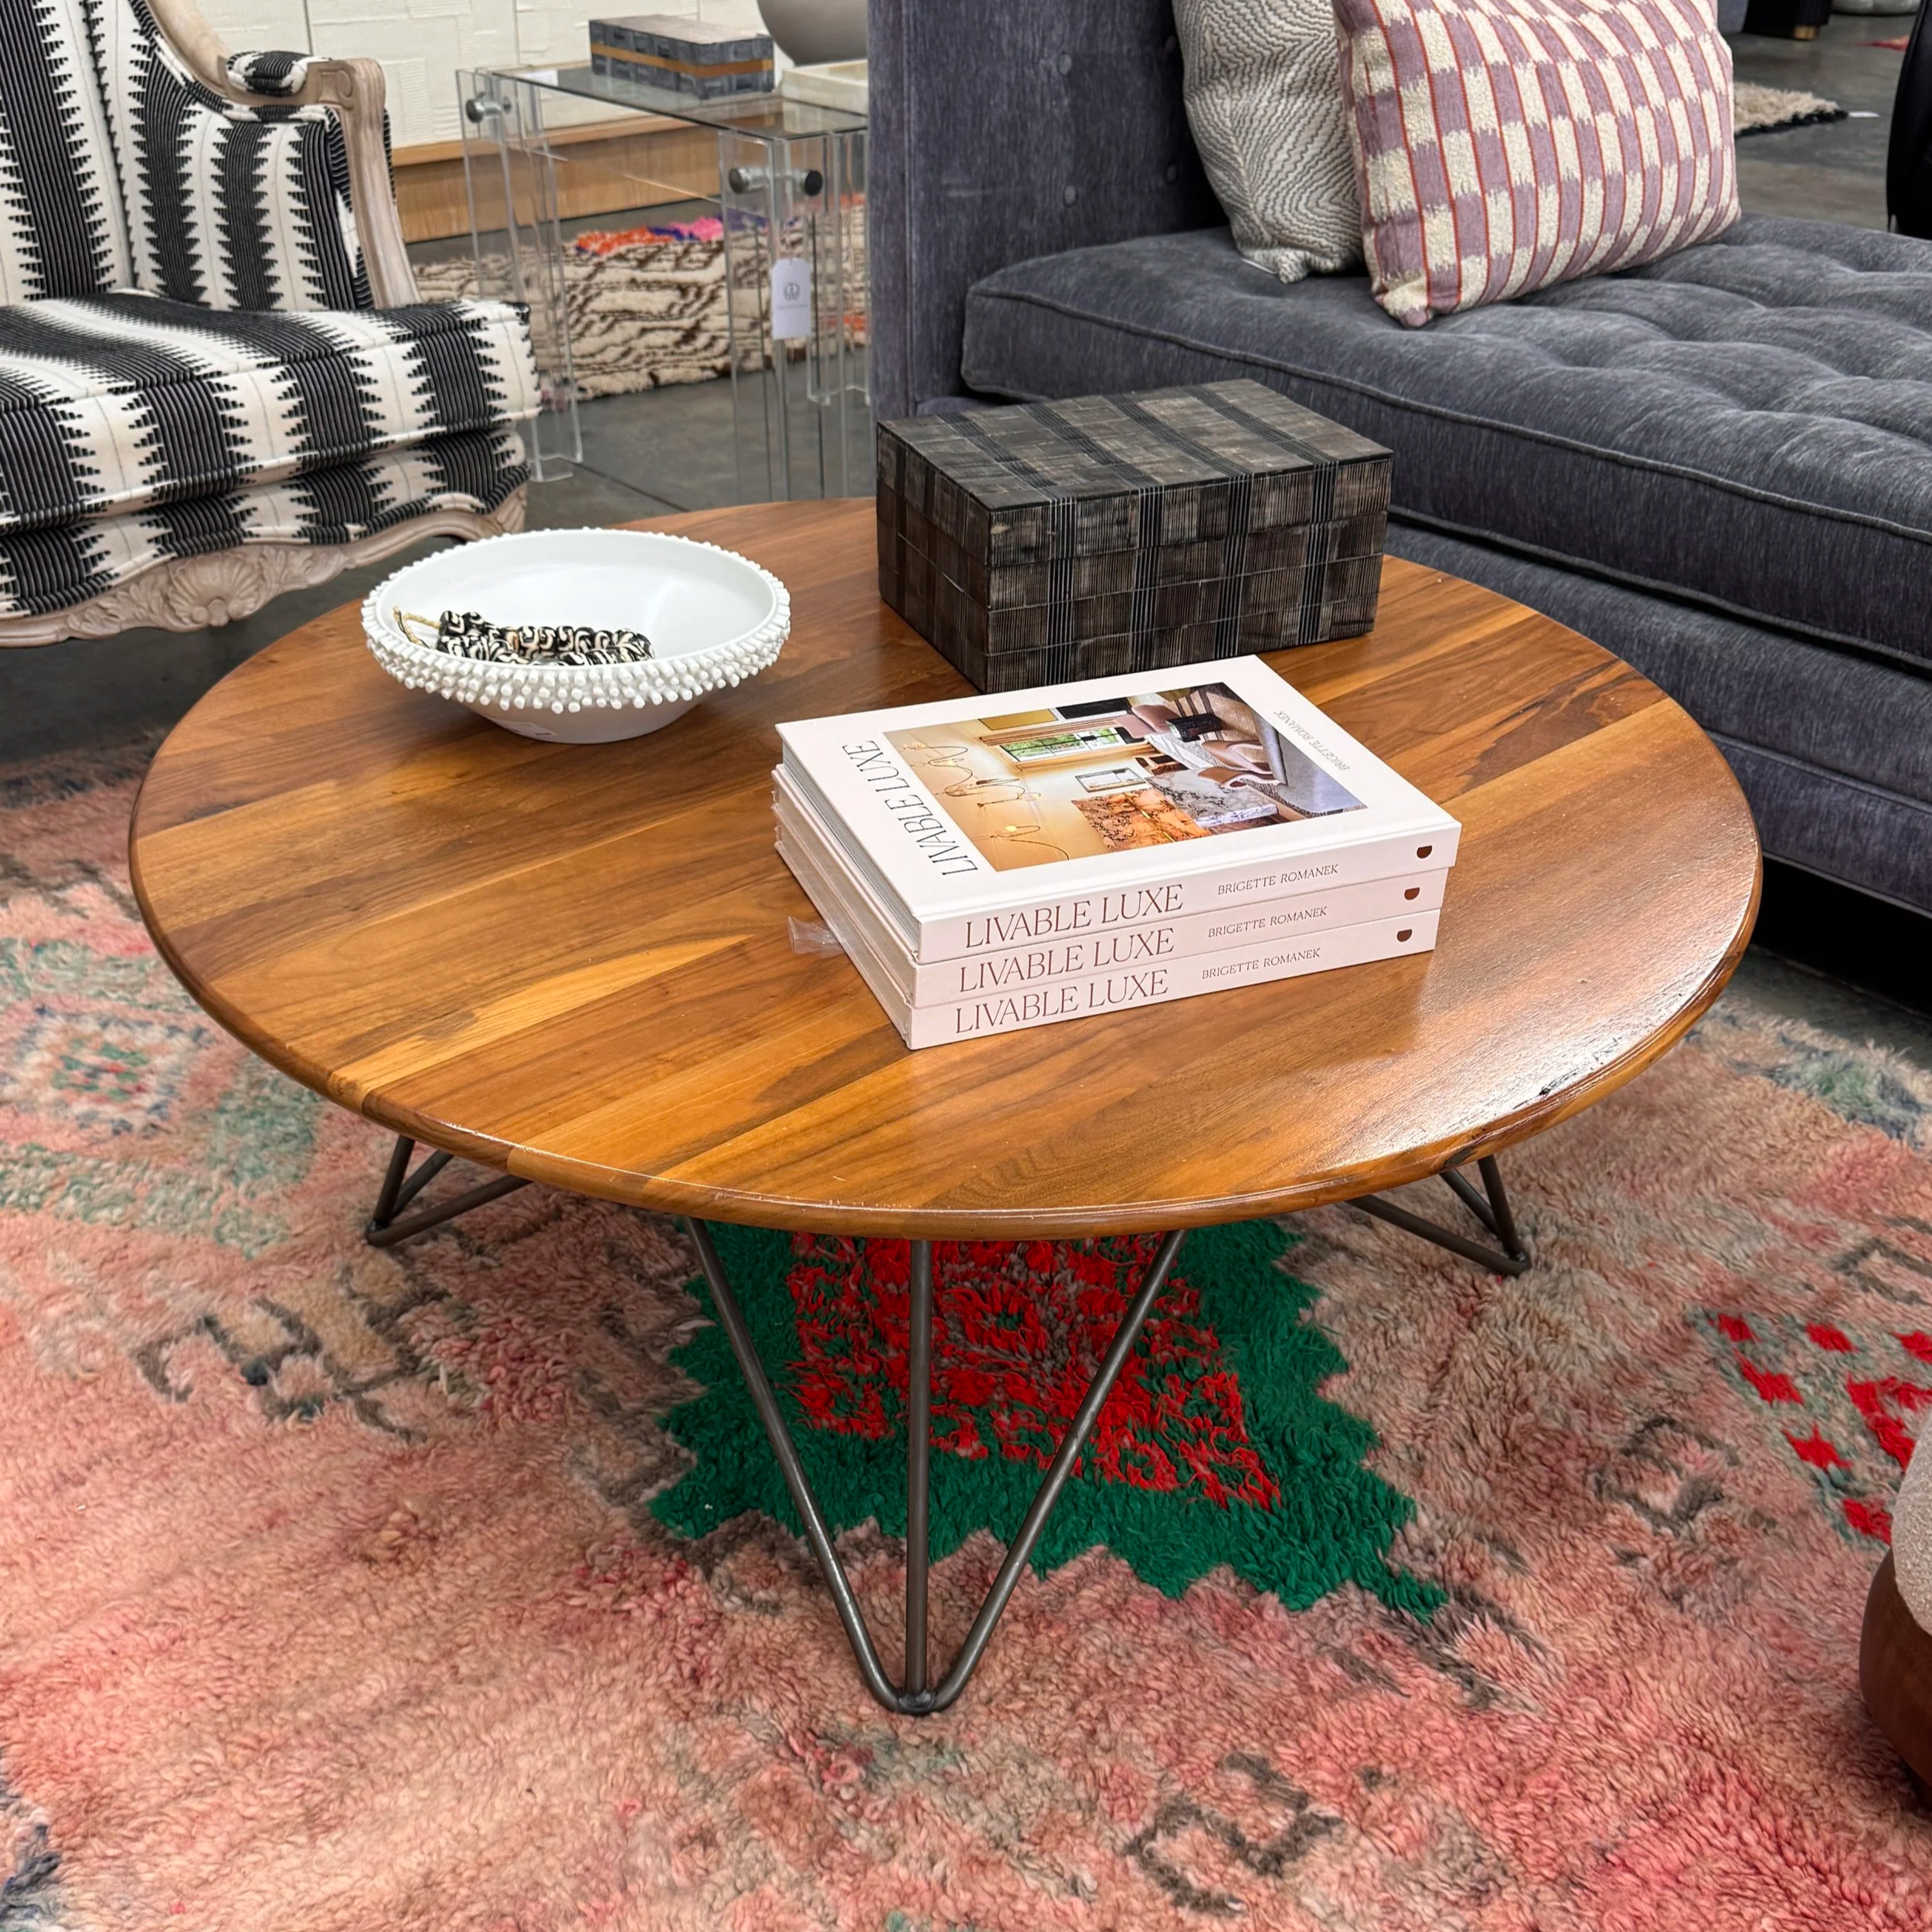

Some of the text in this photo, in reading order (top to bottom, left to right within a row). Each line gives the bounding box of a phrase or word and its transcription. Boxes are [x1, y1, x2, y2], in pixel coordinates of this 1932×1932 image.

[1273, 710, 1350, 770] BRIGETTE ROMANEK
[842, 740, 978, 876] LIVABLE LUXE
[966, 863, 1339, 948] LIVABLE LUXE BRIGETTE ROMANEK
[955, 947, 1321, 1034] LIVABLE LUXE BRIGETTE ROMANEK
[960, 906, 1328, 992] LIVABLE LUXE BRIGETTE ROMANEK
